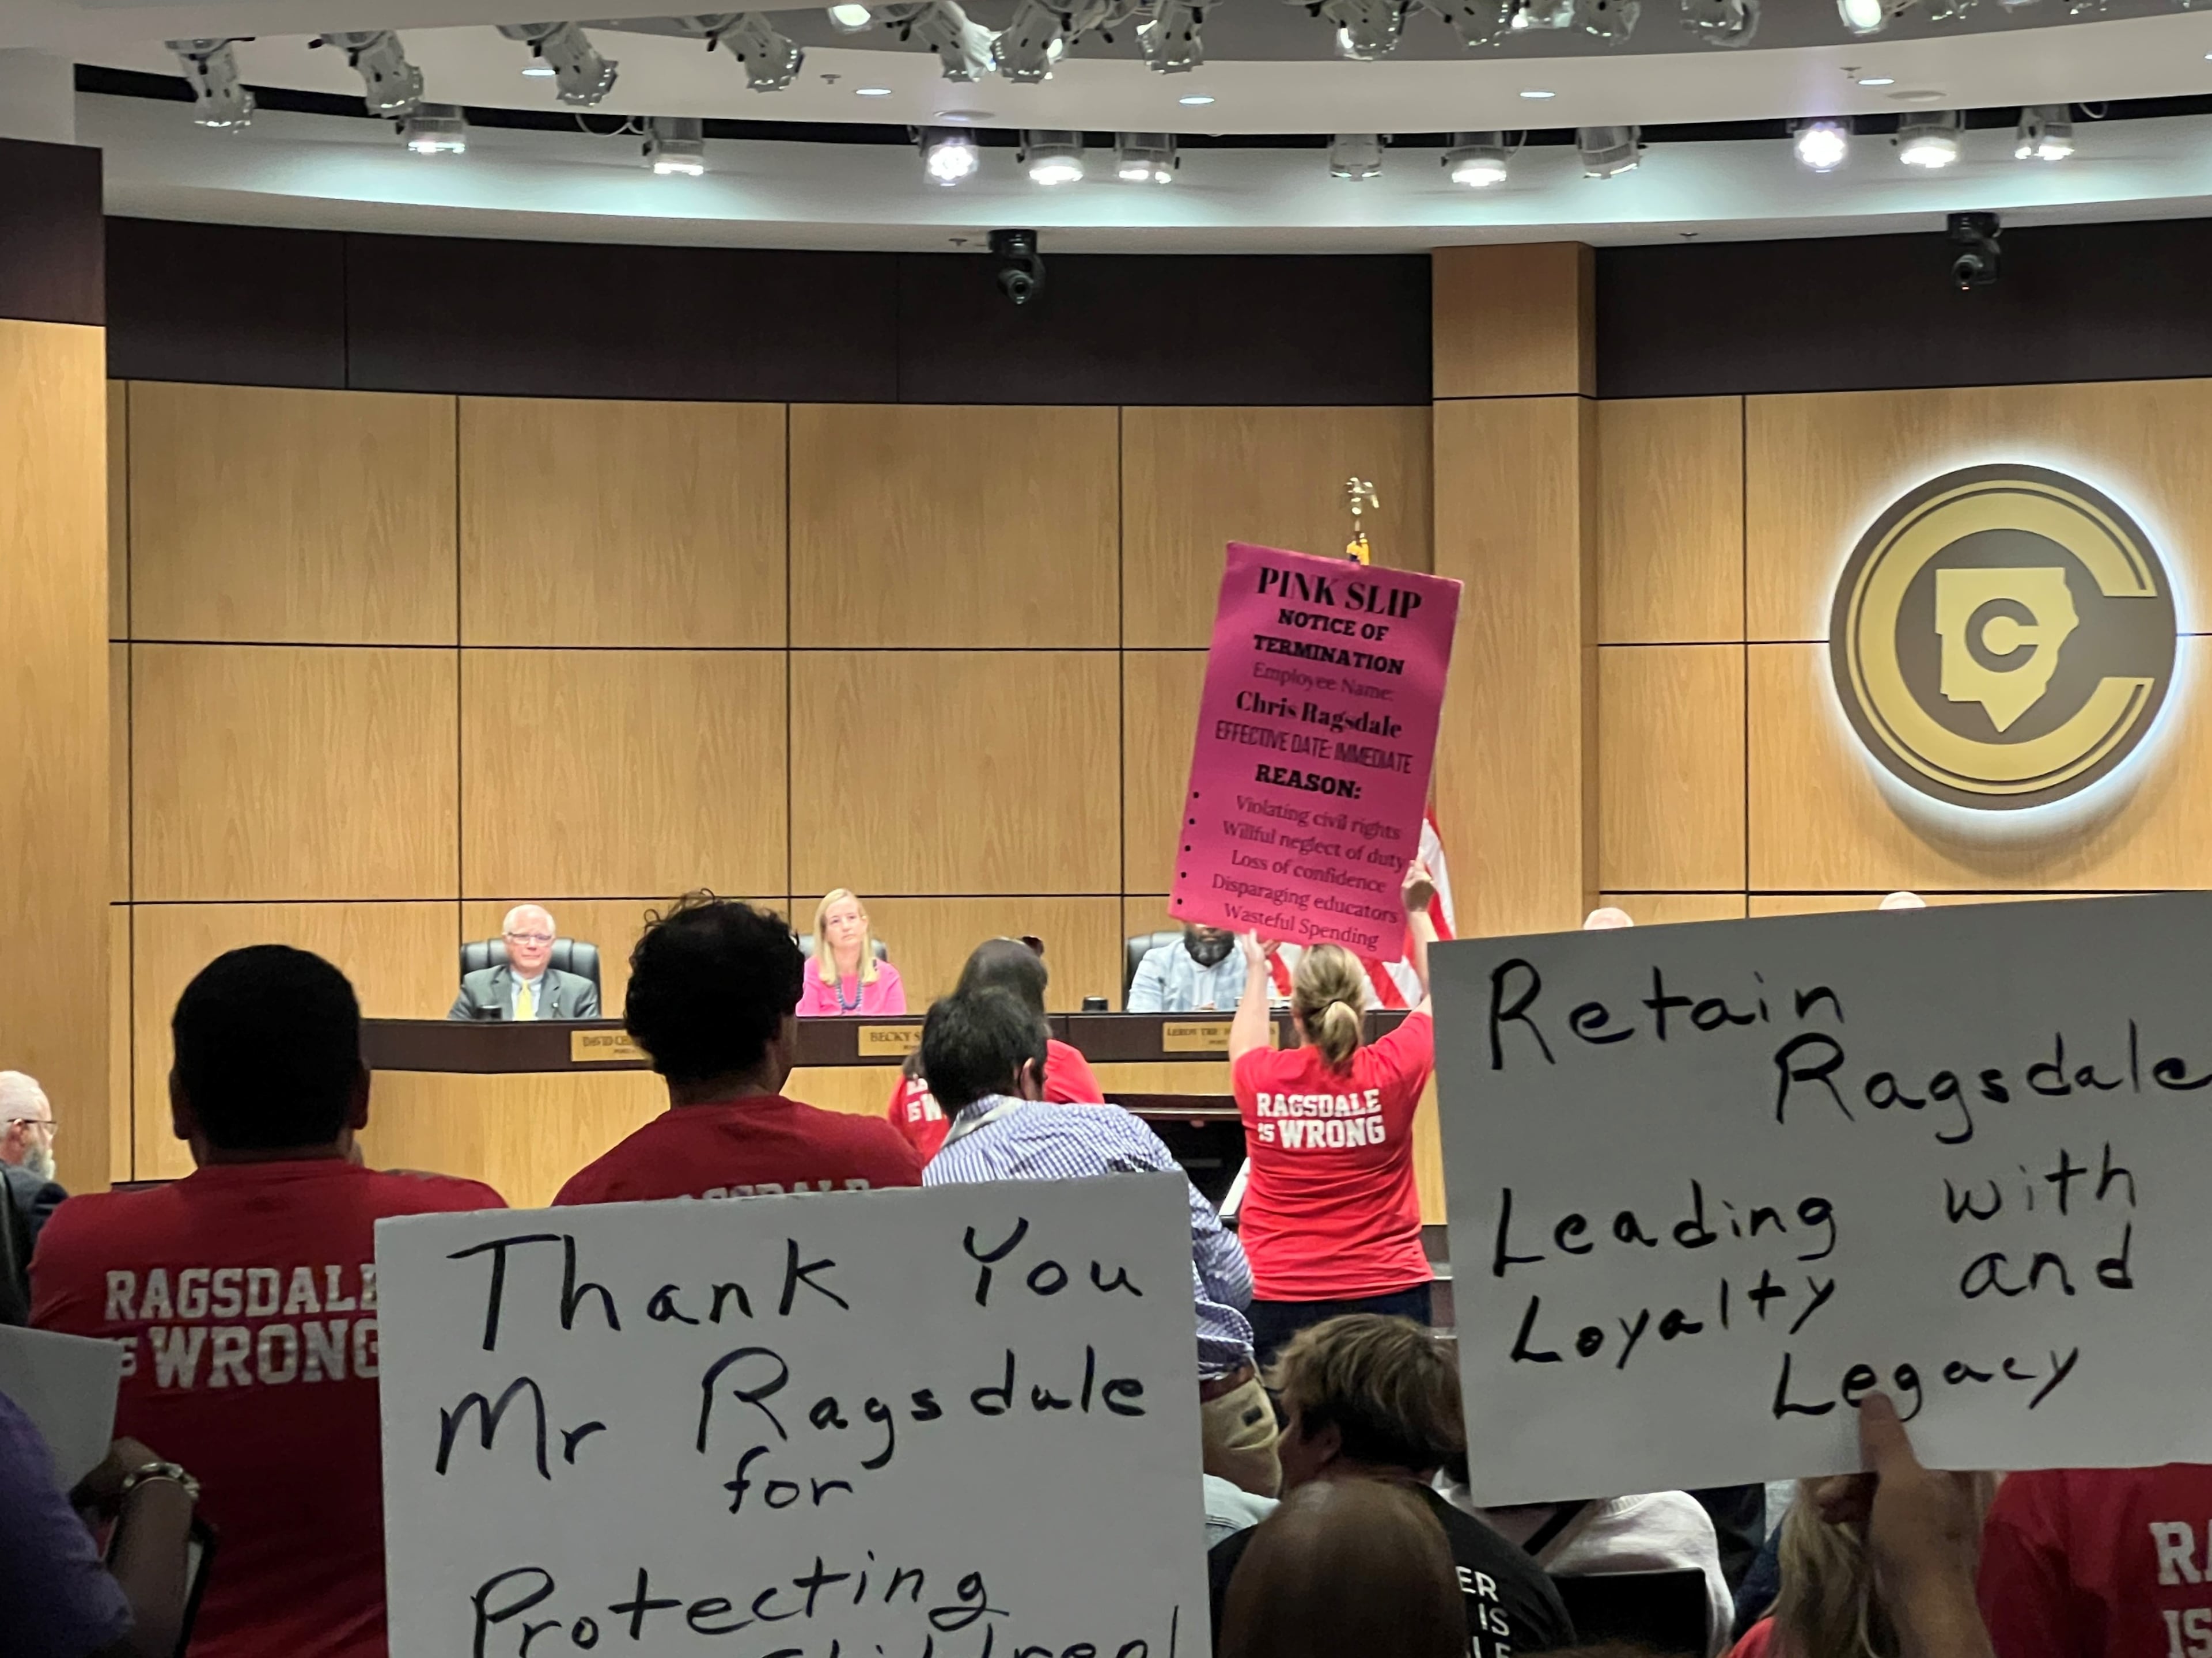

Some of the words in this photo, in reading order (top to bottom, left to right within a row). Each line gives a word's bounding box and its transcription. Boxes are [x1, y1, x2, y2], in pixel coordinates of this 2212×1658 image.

[1256, 567, 1338, 606] PINK
[1344, 581, 1422, 619] SLIP
[1278, 609, 1356, 636] NOTICE
[1361, 623, 1389, 641] OF
[1253, 635, 1405, 675] TERMINATION
[1253, 662, 1337, 690] Employee
[1215, 720, 1289, 751] EFFECTIVE
[1236, 690, 1297, 718] Chris
[1301, 702, 1402, 739] Ragsdale
[1255, 764, 1362, 799] REASON:
[1237, 795, 1311, 828] Violating
[1313, 811, 1348, 830] civil
[1351, 817, 1402, 841] rights
[1223, 820, 1277, 844] Willful
[1279, 833, 1342, 856] neglect
[1345, 844, 1368, 860] of
[1367, 848, 1406, 874] duty
[1232, 849, 1268, 870] Loss
[1272, 859, 1294, 875] of
[1293, 865, 1387, 894] confidence
[1211, 873, 1311, 910] Disparaging
[1313, 896, 1399, 924] educators
[1225, 902, 1295, 931] Wasteful
[1298, 919, 1379, 951] Spending
[1490, 958, 1846, 1071] Retain
[1256, 1088, 1381, 1117] RAGSDALE
[1774, 1018, 2212, 1145] Ragsdale
[1258, 1122, 1275, 1142] IS
[1277, 1115, 1385, 1148] WRONG
[1493, 1178, 1836, 1278] Leading
[1944, 1141, 2137, 1224] with
[446, 1233, 850, 1352] Thank
[962, 1216, 1144, 1308] You
[1510, 1268, 1836, 1371] Loyalty
[1960, 1221, 2134, 1300] and
[148, 1318, 378, 1388] WRONG
[1772, 1346, 2079, 1422] Legacy
[434, 1375, 608, 1482] Mr
[695, 1344, 1147, 1471] Ragsdale
[722, 1444, 854, 1515] for
[469, 1549, 1010, 1658] Protecting
